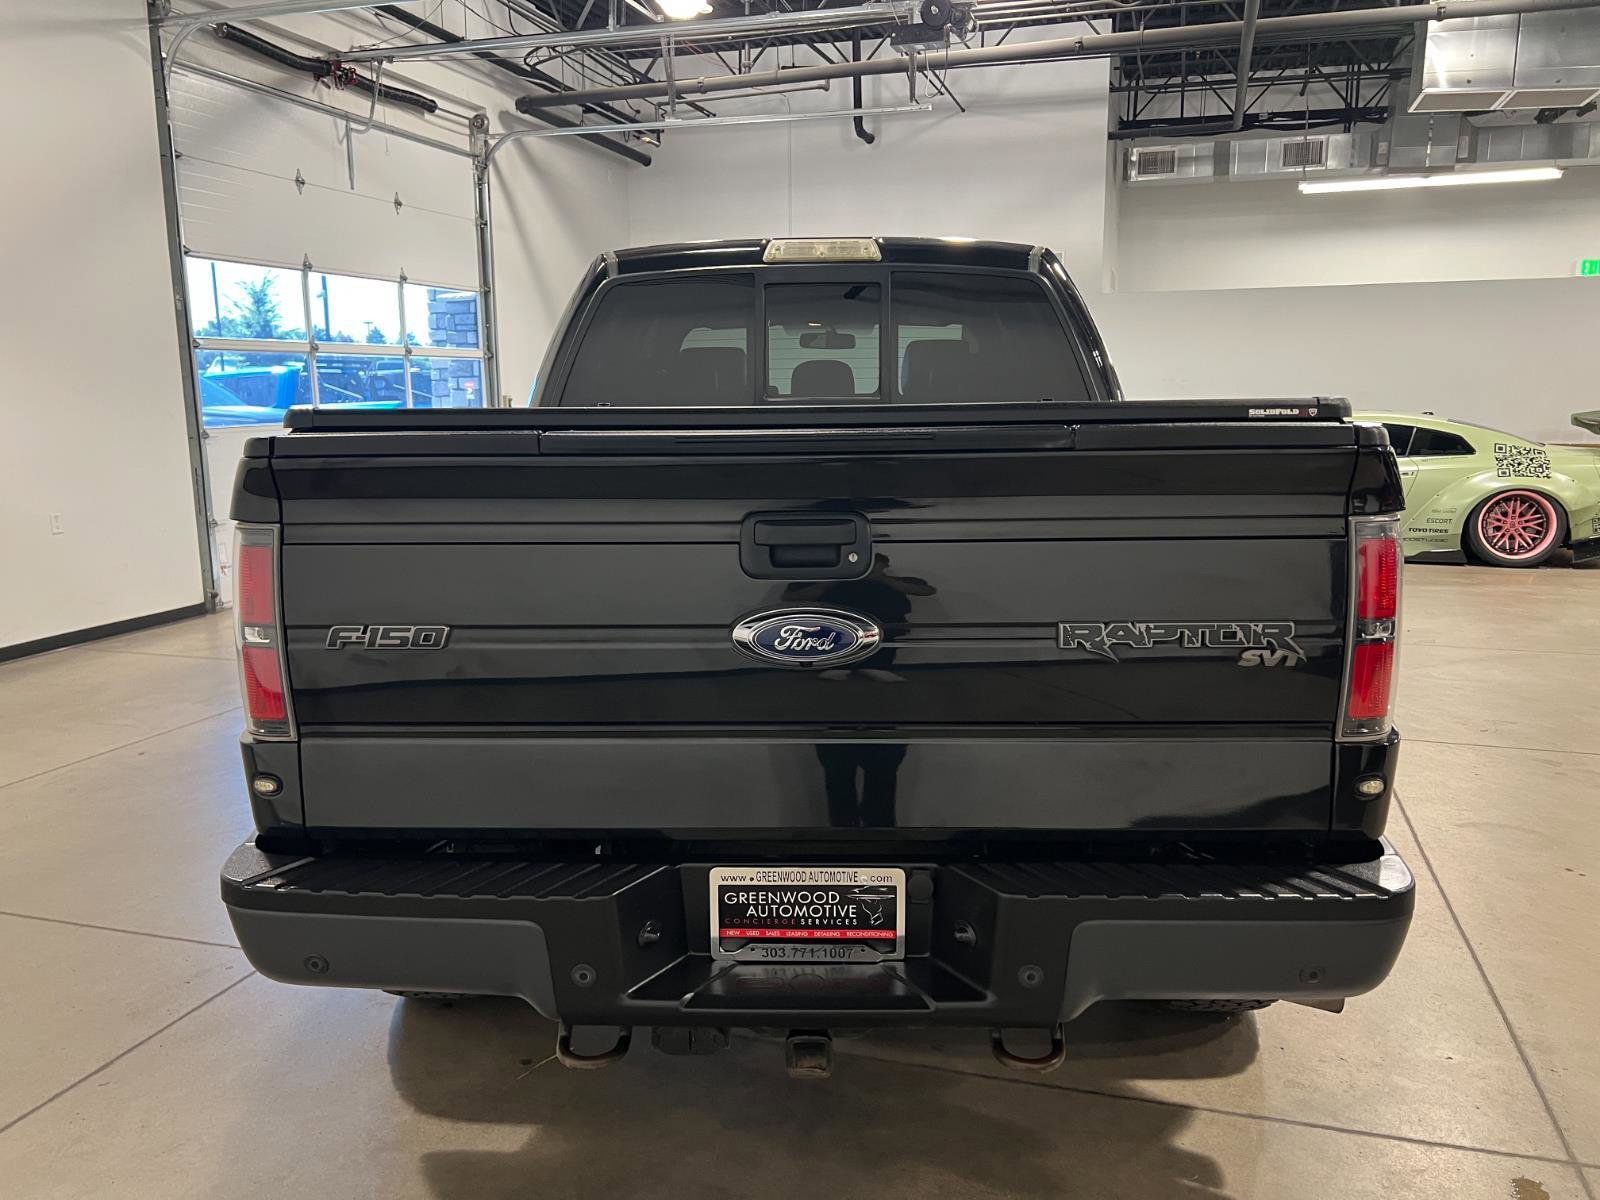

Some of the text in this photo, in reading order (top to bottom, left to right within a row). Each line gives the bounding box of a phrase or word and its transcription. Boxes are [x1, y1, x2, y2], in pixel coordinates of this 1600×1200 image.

[1426, 517, 1453, 525] ESCORT
[326, 625, 450, 650] F-150
[773, 625, 837, 651] Ford
[1057, 621, 1307, 664] RAPTOR
[1237, 649, 1298, 667] SVT
[755, 871, 807, 883] GREENWOOD
[809, 871, 859, 883] AUTOMOTIVE
[724, 891, 840, 904] GREENWOOD
[746, 905, 857, 918] AUTOMOTIVE
[800, 918, 858, 926] SERVICES
[761, 948, 852, 959] 303.771.1007
